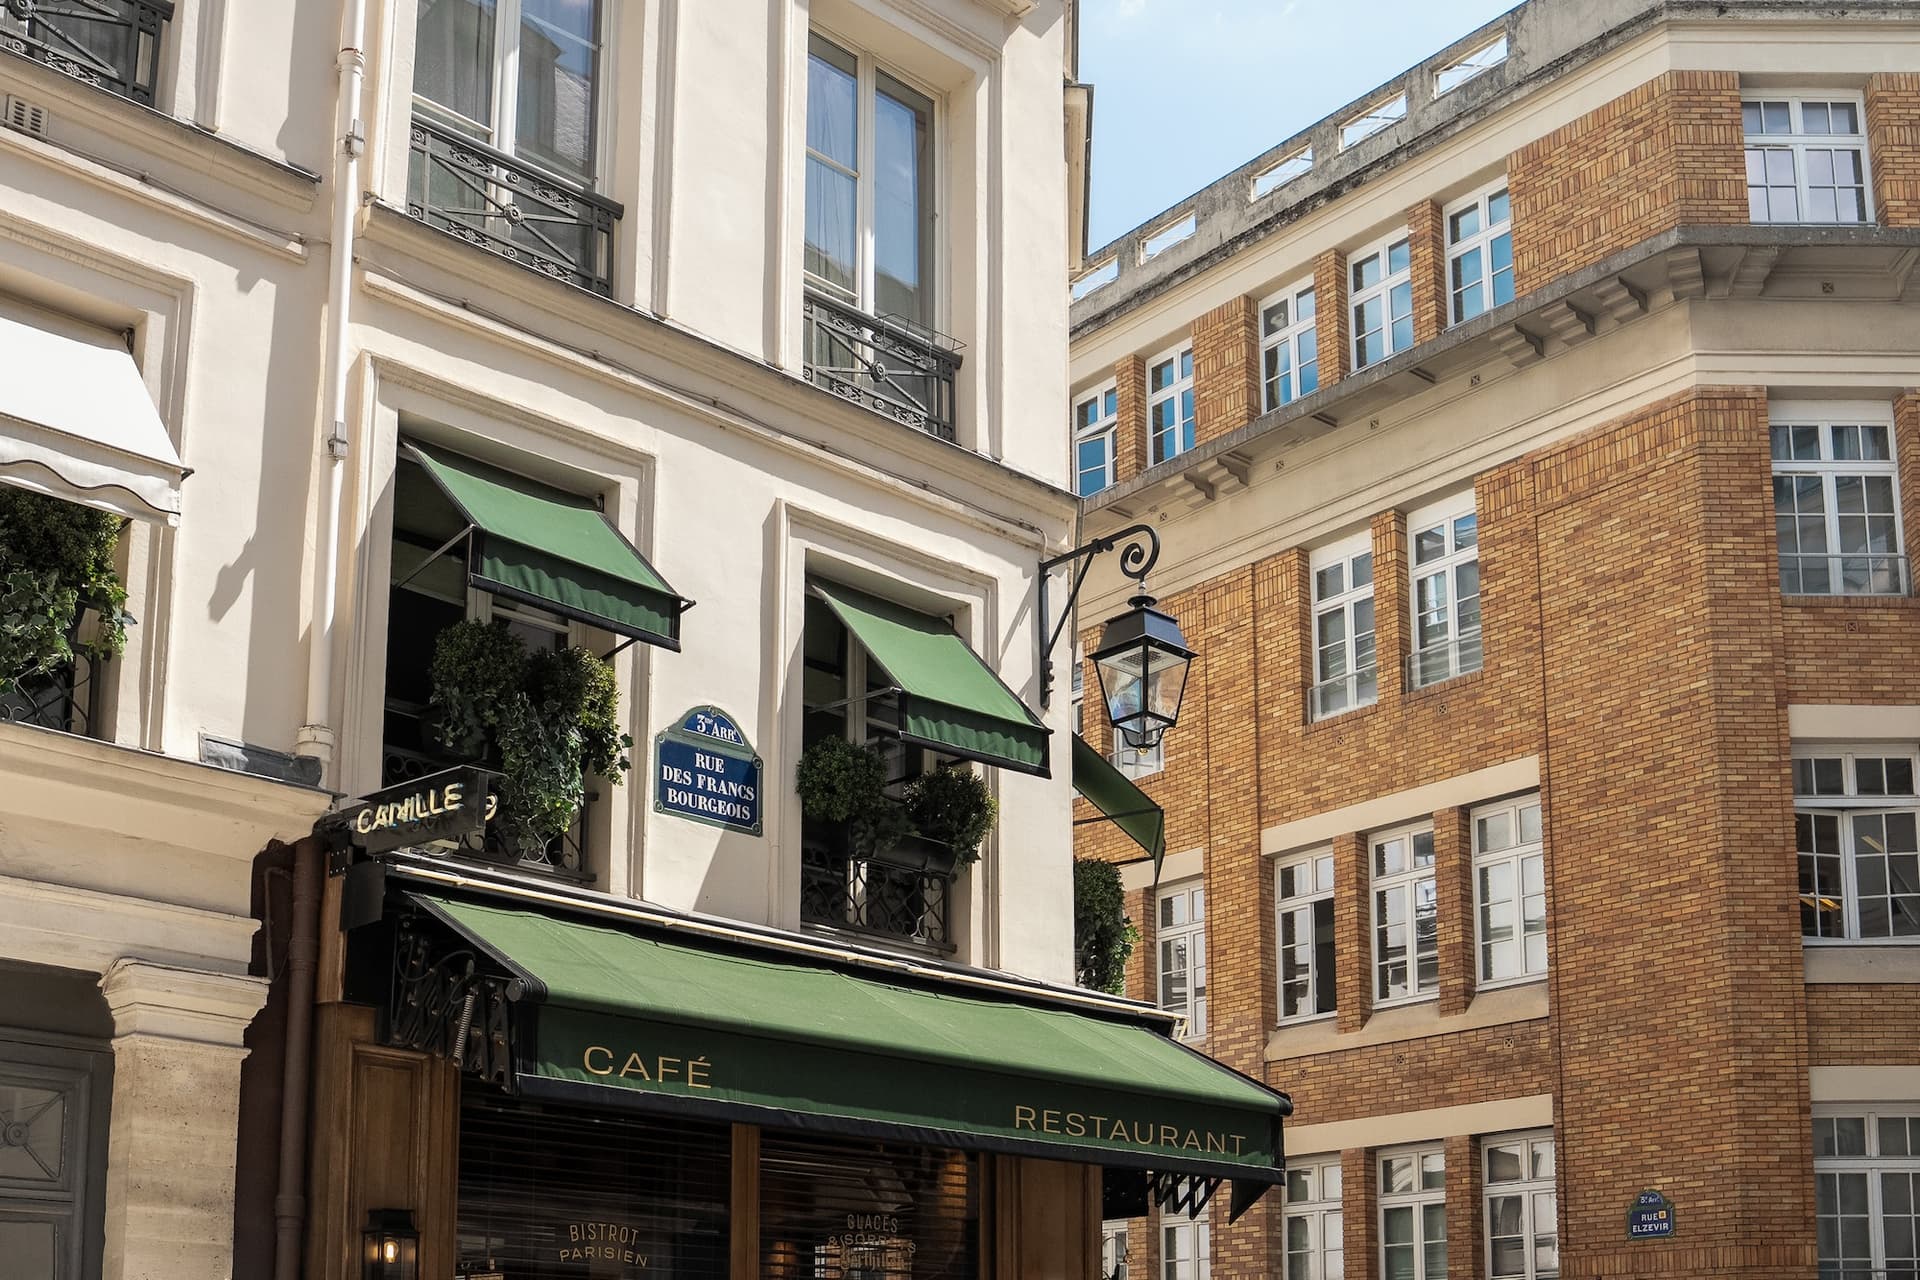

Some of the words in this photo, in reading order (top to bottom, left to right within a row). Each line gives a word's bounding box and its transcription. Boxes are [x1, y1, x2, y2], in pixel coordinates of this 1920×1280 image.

[695, 752, 724, 774] RUE
[662, 764, 692, 786] DES
[696, 774, 755, 801] FRANCS
[357, 783, 464, 834] CAMILLE
[667, 787, 751, 820] BOURGEOIS
[584, 1046, 712, 1089] CAFÉ
[1015, 1105, 1246, 1157] RESTAURANT
[847, 1214, 898, 1233] GLACES
[1632, 1222, 1669, 1233] ELZEVIR
[1641, 1212, 1659, 1222] RUE
[569, 1223, 639, 1246] BISTROT
[560, 1246, 648, 1267] PARISIEN
